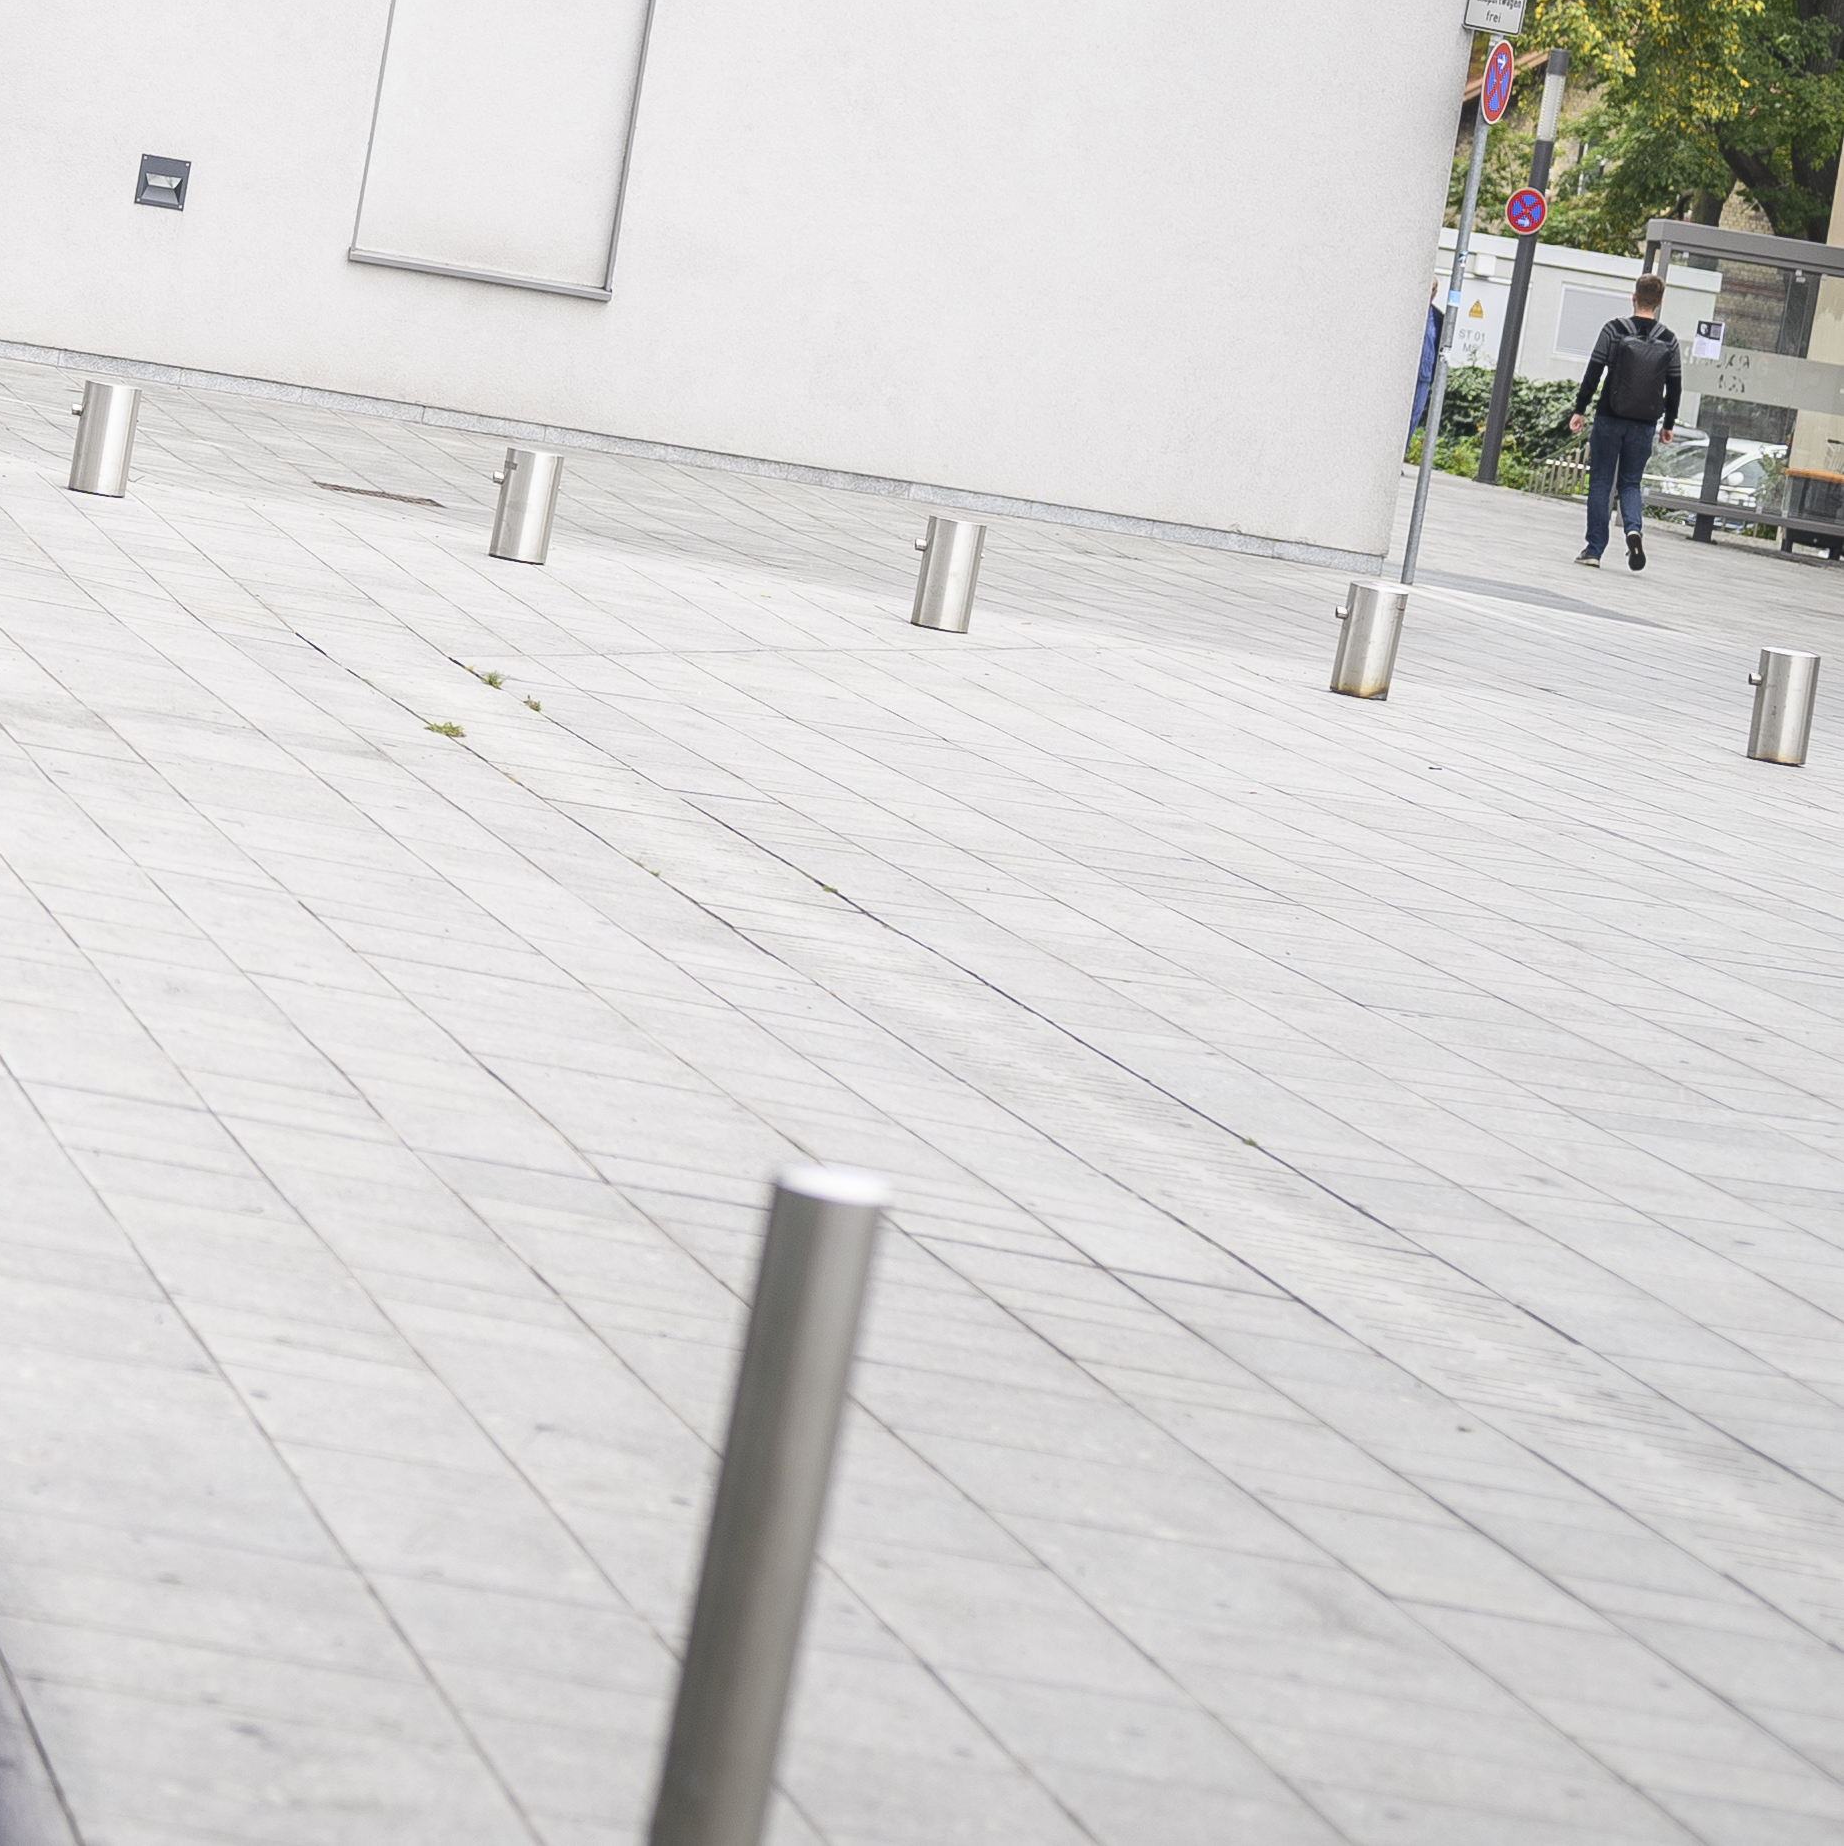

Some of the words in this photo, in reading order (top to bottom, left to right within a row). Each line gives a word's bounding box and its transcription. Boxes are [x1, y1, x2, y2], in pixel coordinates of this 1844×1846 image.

[1485, 10, 1503, 23] frei
[1457, 328, 1473, 340] ST
[1474, 332, 1486, 343] 01
